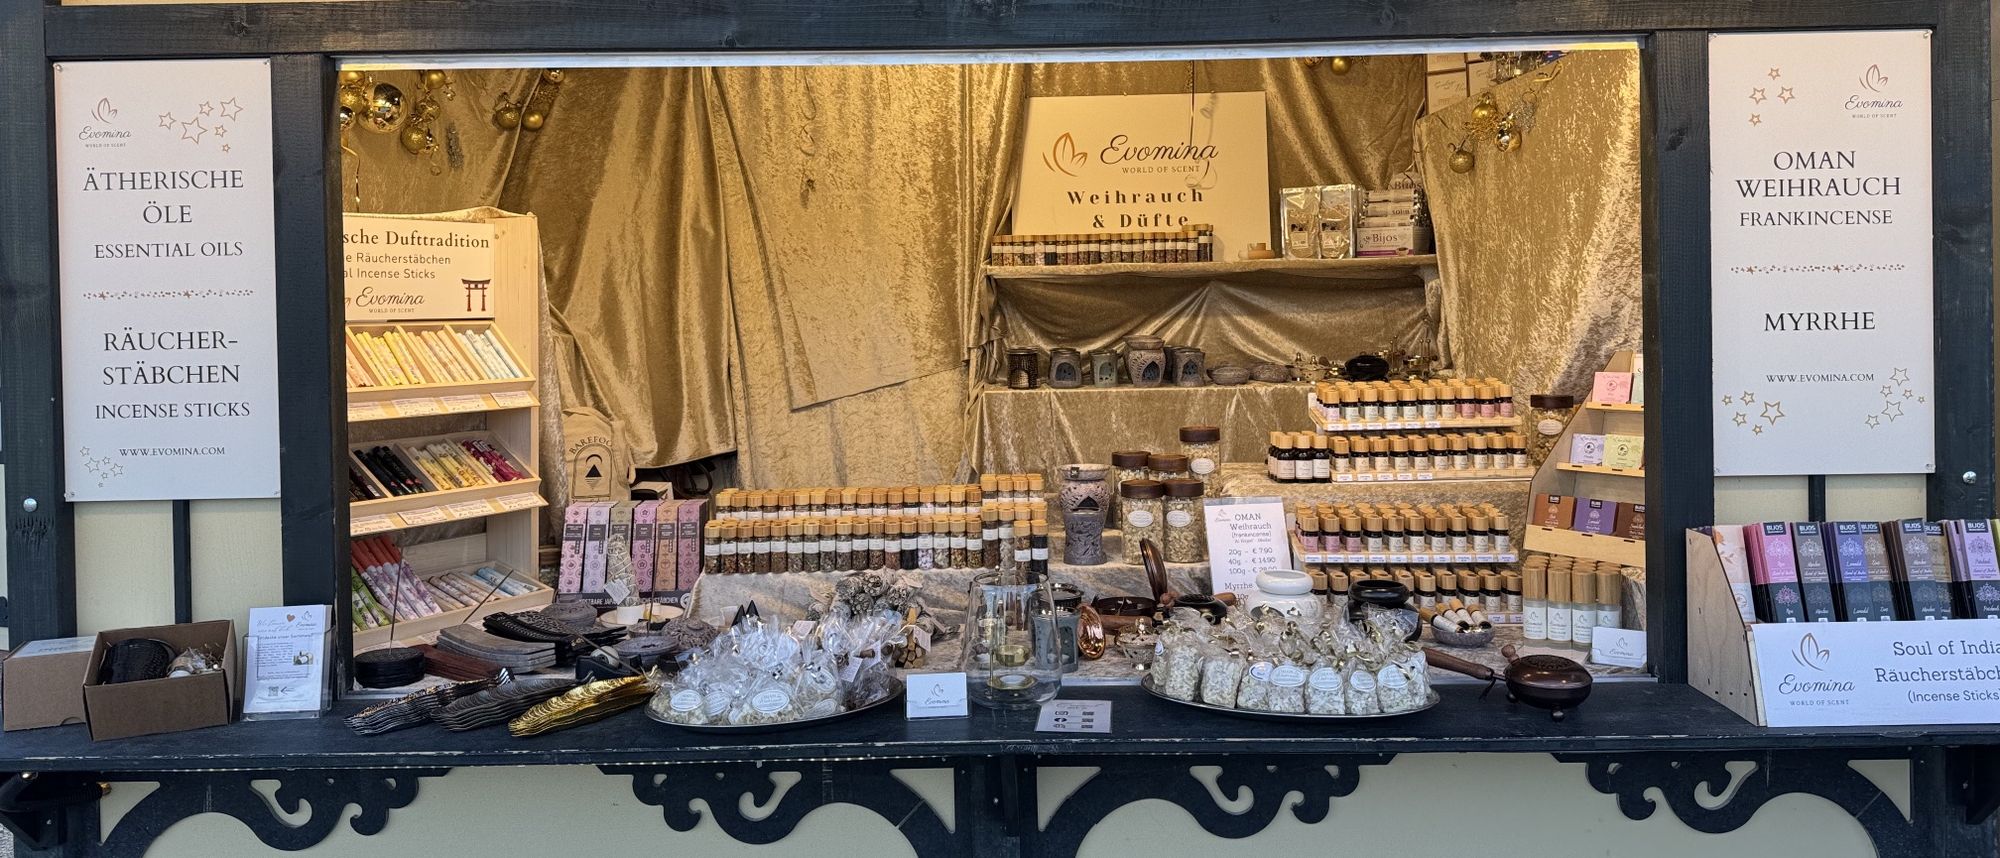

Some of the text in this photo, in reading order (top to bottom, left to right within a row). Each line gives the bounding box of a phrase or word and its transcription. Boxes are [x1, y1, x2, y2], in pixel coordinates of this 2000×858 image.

[1845, 94, 1903, 110] Evomina
[79, 125, 131, 141] Evomina
[1100, 134, 1219, 165] Evomina
[1773, 151, 1856, 170] OMAN
[1156, 166, 1168, 174] OF
[1171, 165, 1200, 173] SCENT
[83, 167, 244, 191] ÄTHERISCHE
[1736, 177, 1901, 198] WEIHRAUCH
[1067, 188, 1203, 205] Weihrauch
[143, 201, 193, 224] ÖLE
[1092, 213, 1189, 229] & Düfte
[1740, 209, 1893, 226] FRANKINCENSE
[385, 230, 489, 248] Dufttradition
[94, 241, 243, 260] ESSENTIAL OILS
[356, 253, 451, 265] Räucherstäbchen
[357, 268, 400, 279] Incense
[403, 268, 435, 279] Sticks
[356, 286, 425, 307] Evomina
[1764, 312, 1876, 332] MYRRHE
[104, 327, 238, 351] RÄUCHER-
[103, 360, 240, 385] STÄBCHEN
[1766, 373, 1874, 383] WWW.EVOMINA.COM
[96, 402, 250, 419] INCENSE STICKS
[119, 447, 225, 457] WWW.EVOMINA.COM
[1234, 513, 1261, 521] OMAN
[1230, 522, 1271, 531] Weihrauch
[1224, 582, 1253, 591] Myrrhe
[1893, 640, 2000, 656] Soul of India
[1778, 673, 1855, 695] Evomina
[1908, 689, 2000, 704] (Incense Sticks
